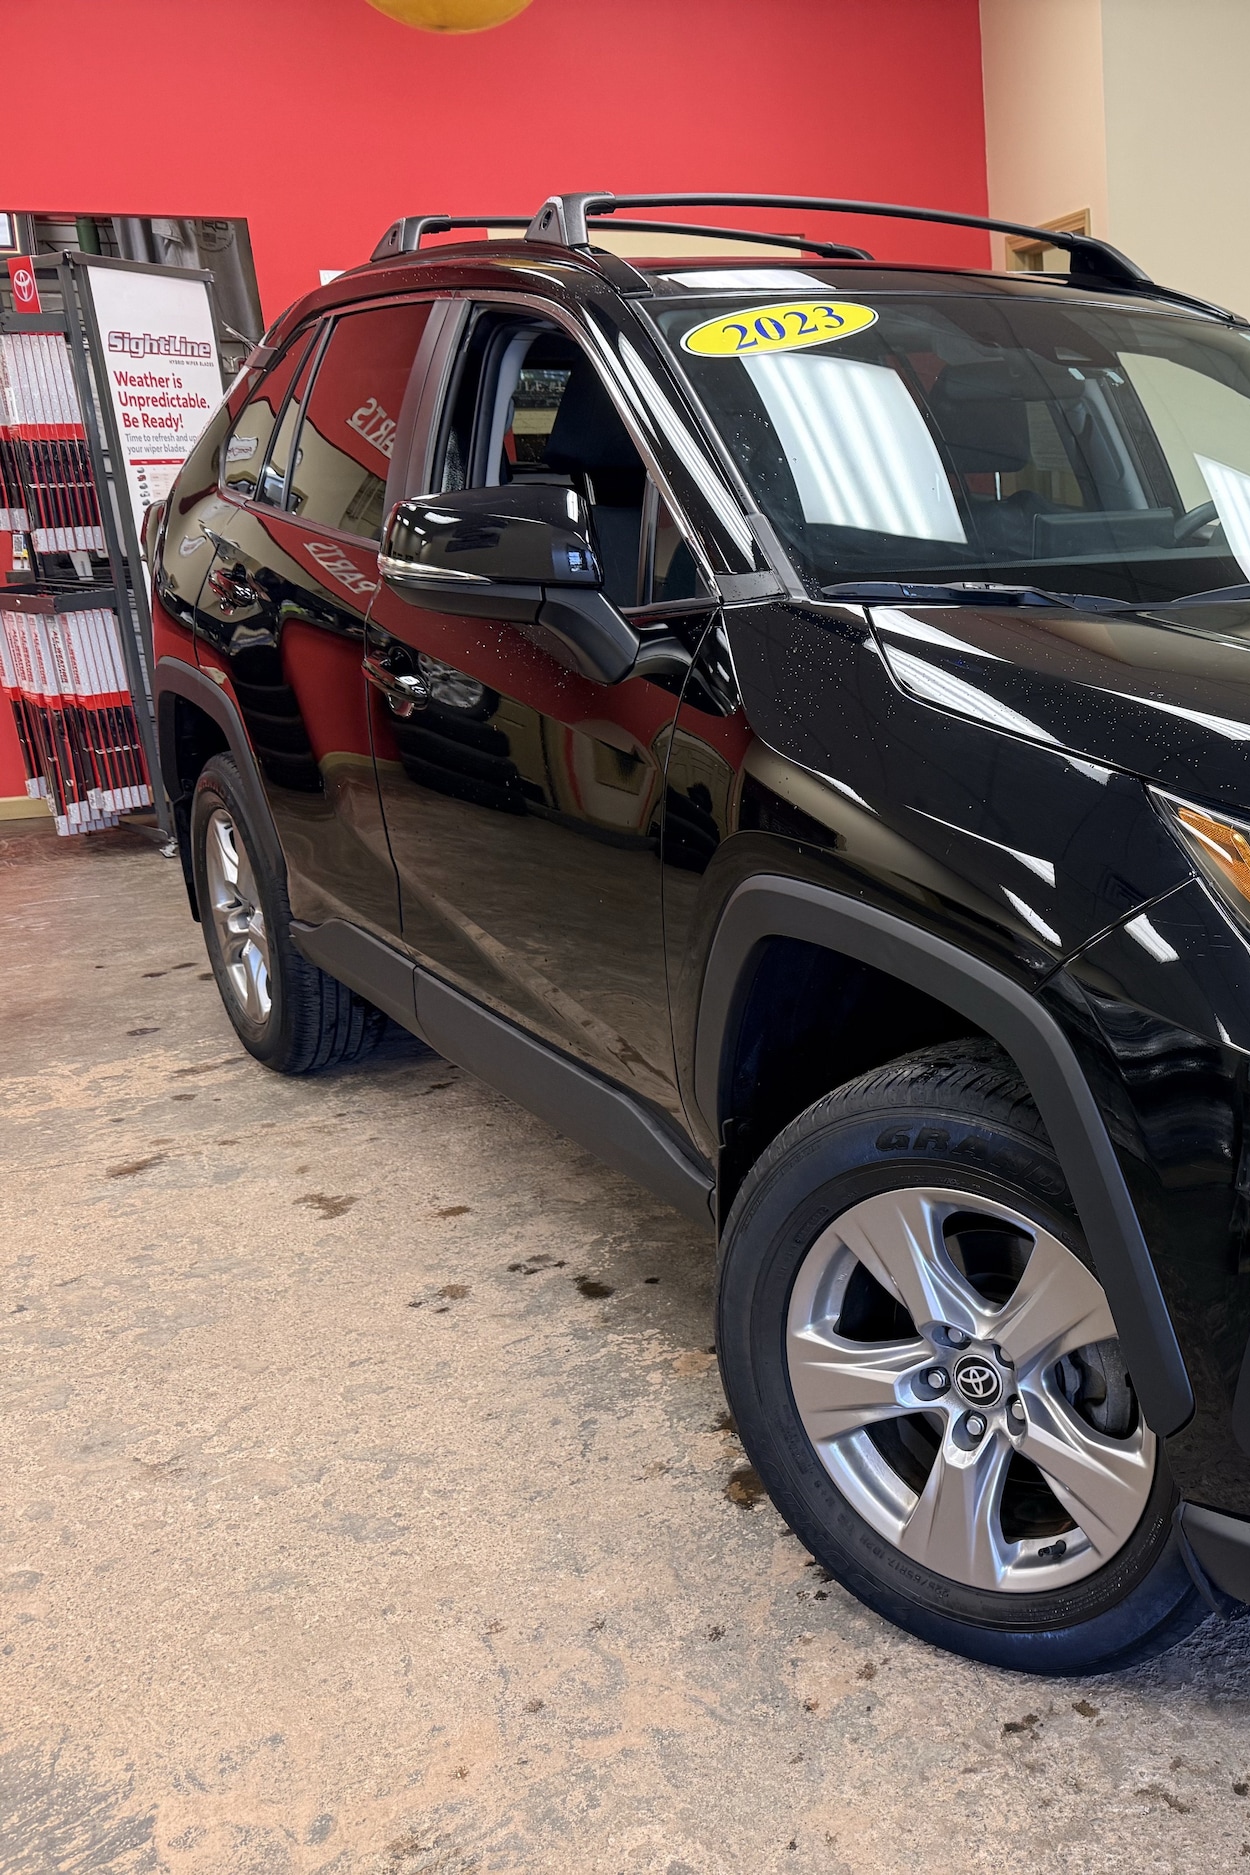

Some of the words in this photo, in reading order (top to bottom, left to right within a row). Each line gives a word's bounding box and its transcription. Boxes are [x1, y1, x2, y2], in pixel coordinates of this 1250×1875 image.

[722, 306, 845, 351] 2023
[107, 331, 212, 359] SightLine
[113, 371, 170, 388] Weather
[172, 373, 183, 389] is
[118, 391, 210, 411] Unpredictable.
[122, 413, 139, 428] Be
[141, 413, 184, 432] Ready!
[125, 433, 142, 442] Time
[143, 434, 150, 442] to
[152, 433, 175, 441] refresh
[176, 433, 187, 441] and
[189, 435, 198, 444] up
[127, 446, 142, 455] your
[144, 445, 163, 454] wiper
[164, 444, 187, 453] blades.
